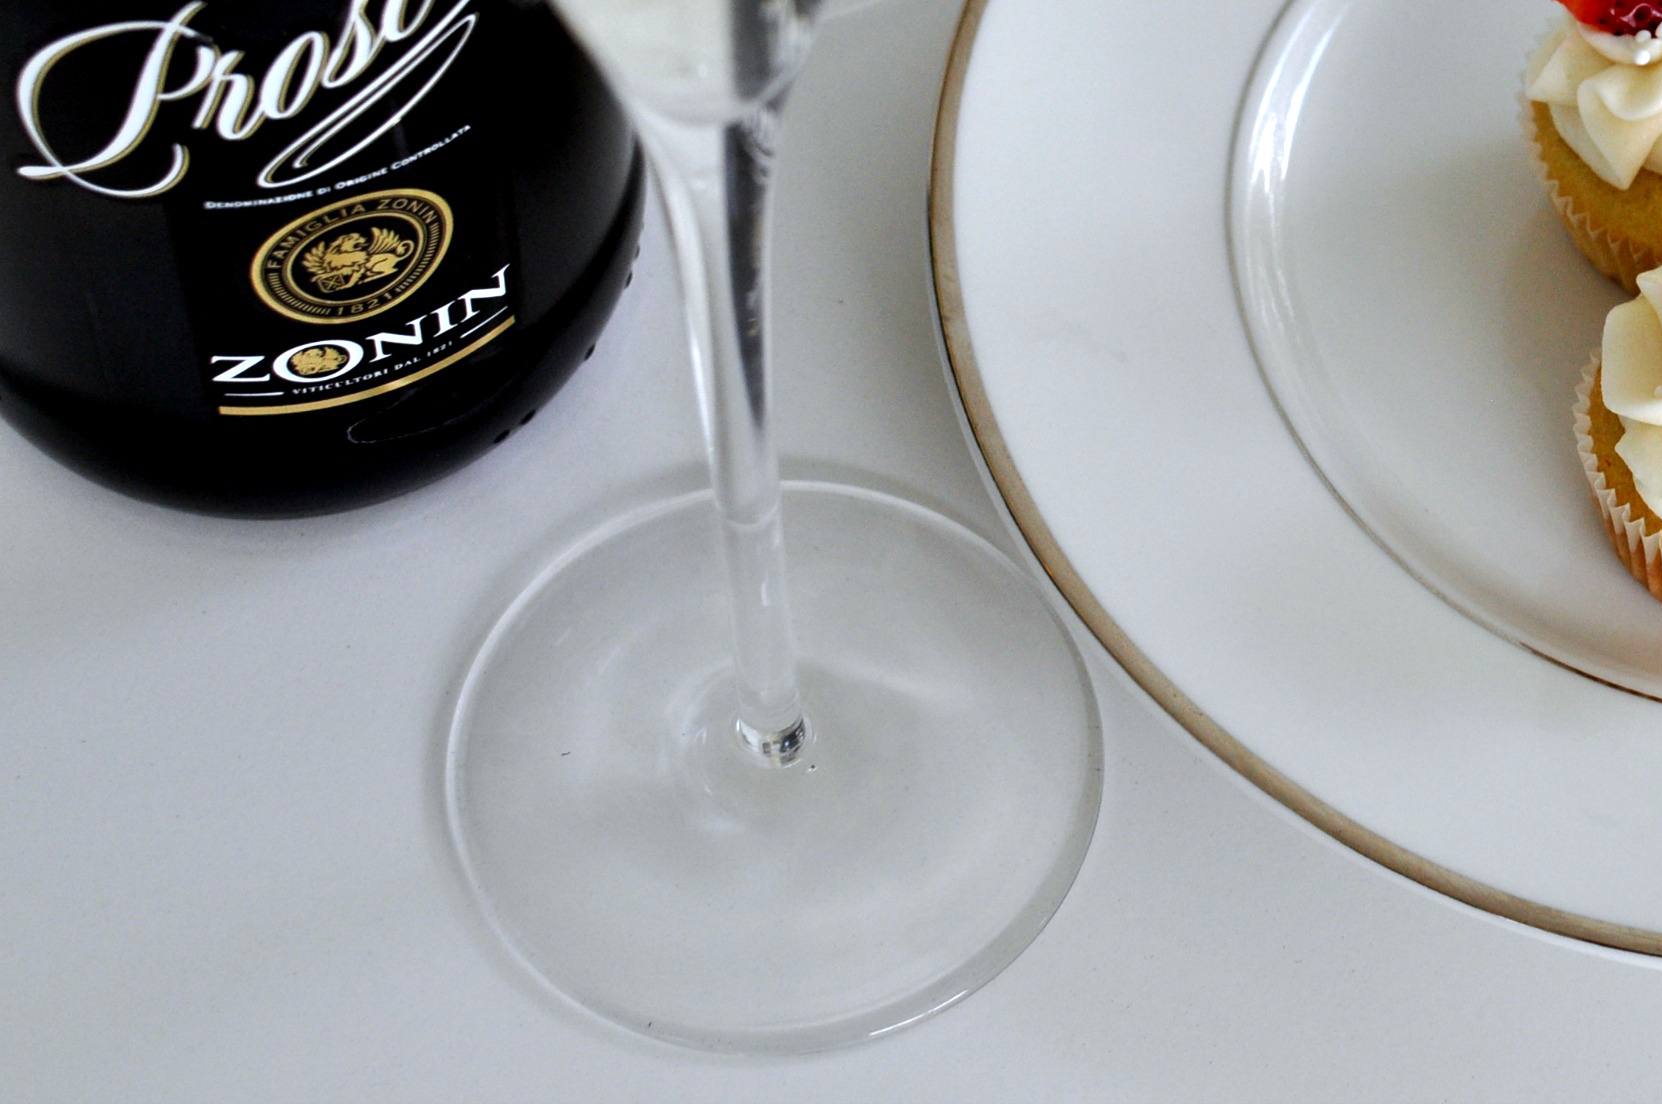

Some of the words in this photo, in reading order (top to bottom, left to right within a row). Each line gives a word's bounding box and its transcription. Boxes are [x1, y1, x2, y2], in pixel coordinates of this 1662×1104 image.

[334, 167, 388, 190] ORIGINE
[391, 125, 471, 170] CONTROLLATA
[267, 203, 366, 269] FAMIGLIA
[378, 198, 439, 225] ZONIN
[210, 263, 510, 383] ZONIN
[336, 292, 391, 316] 1821
[292, 369, 388, 395] VITICULTORI
[394, 356, 421, 371] DAL
[427, 340, 453, 357] 1821
